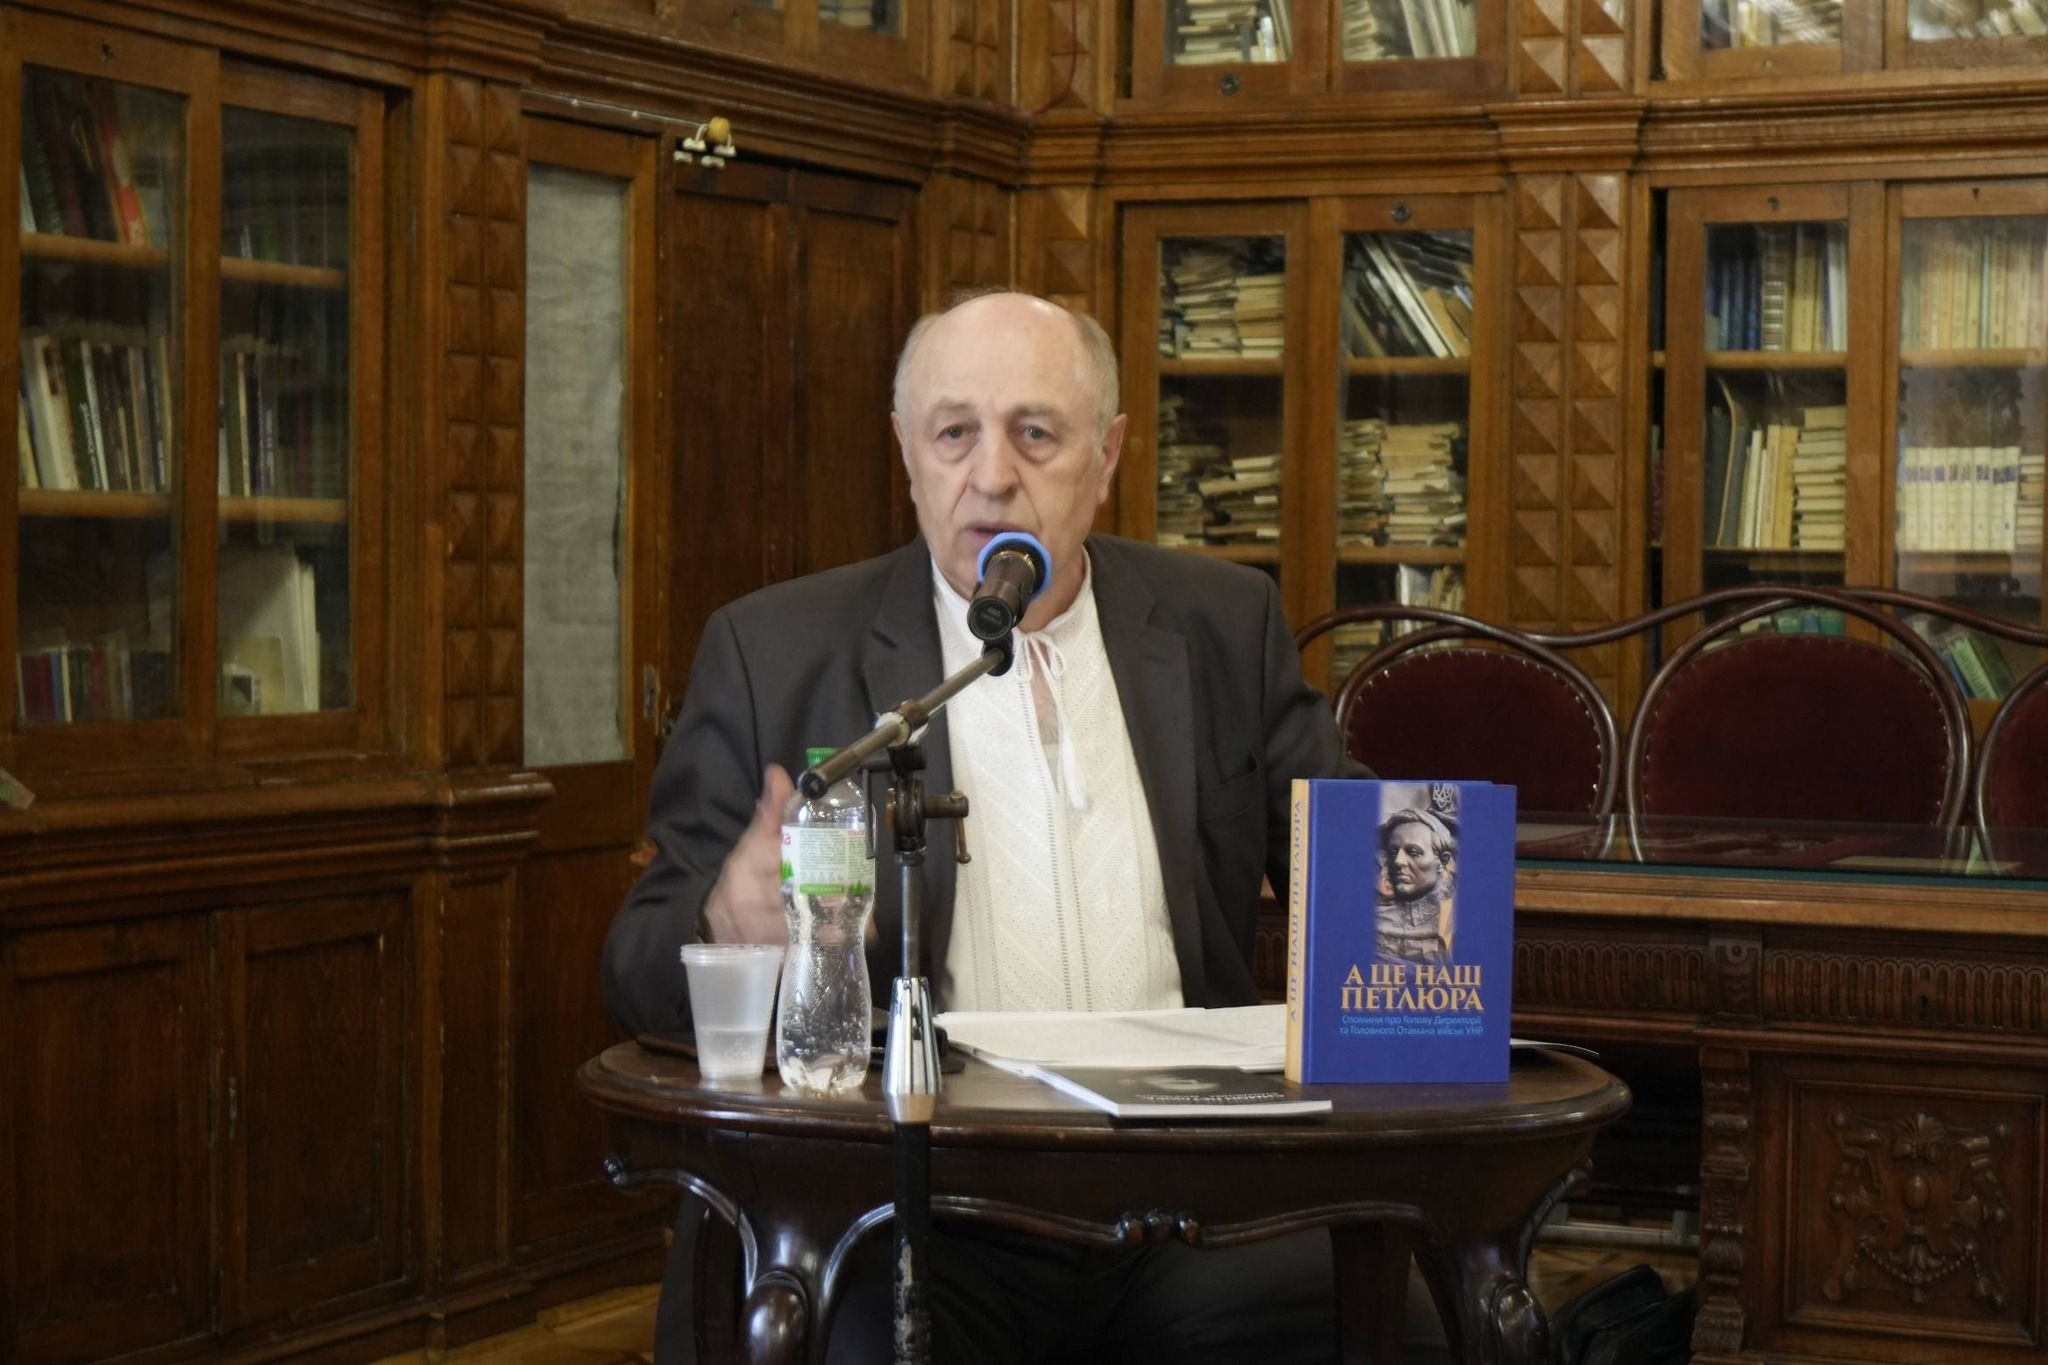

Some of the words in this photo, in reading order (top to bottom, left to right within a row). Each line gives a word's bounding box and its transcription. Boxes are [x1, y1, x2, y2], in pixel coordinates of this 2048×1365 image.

[1344, 963, 1365, 985] А
[1370, 964, 1406, 986] ЦЕ
[1414, 964, 1481, 986] НАШ
[1340, 986, 1485, 1010] ПЕТЛЮРА
[1385, 1016, 1401, 1026] про
[1465, 1026, 1484, 1035] УНР
